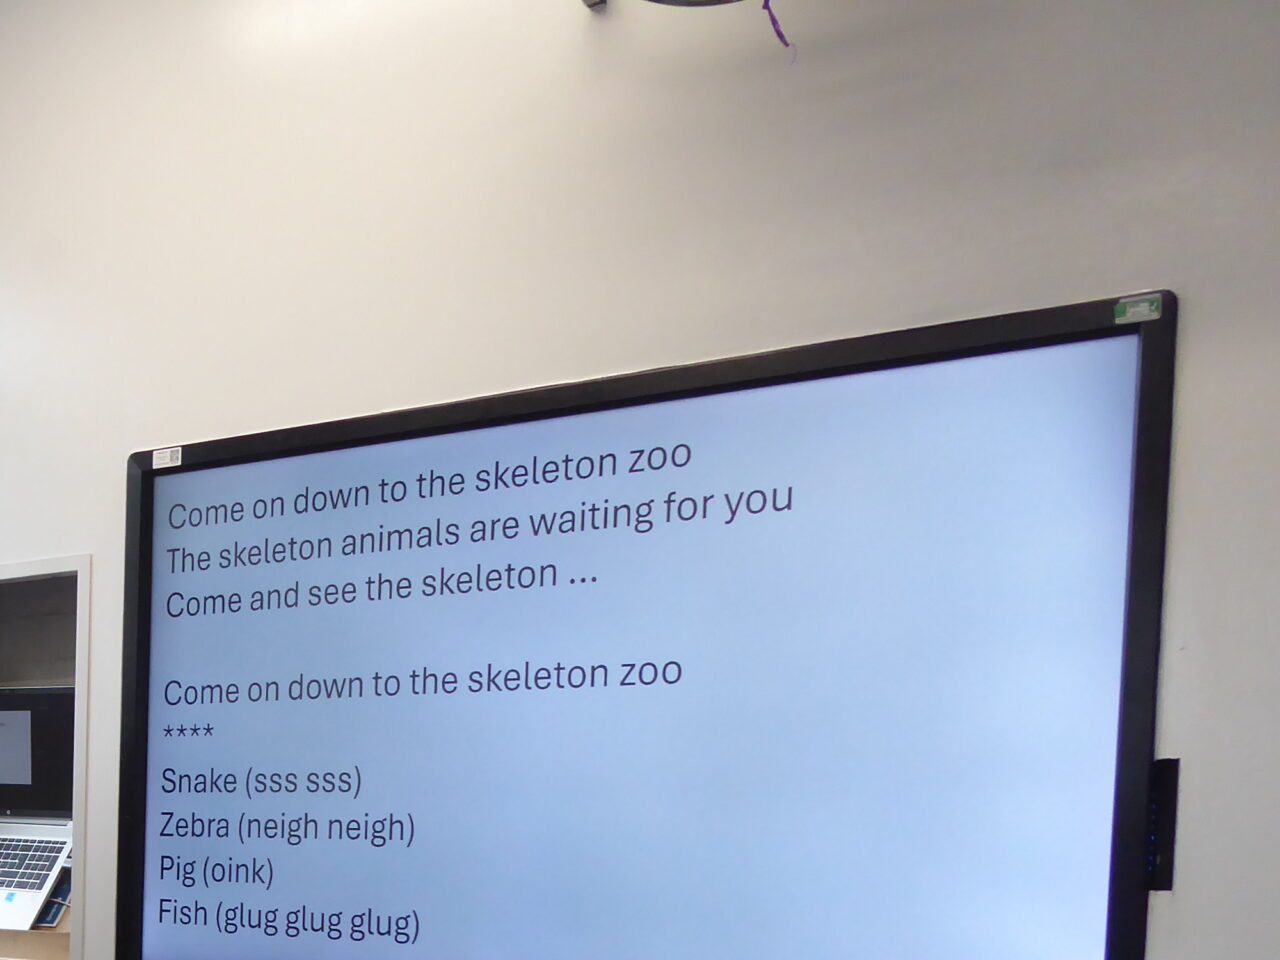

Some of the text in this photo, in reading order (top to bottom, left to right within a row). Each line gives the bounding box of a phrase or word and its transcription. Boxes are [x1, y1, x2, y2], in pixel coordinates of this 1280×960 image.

[168, 443, 692, 530] Come on down to the skeleton zoo
[166, 486, 793, 574] The skeleton animals are waiting for you
[166, 591, 242, 618] Come
[249, 580, 299, 612] and
[308, 582, 357, 607] see
[364, 572, 412, 602] the
[421, 563, 557, 597] skeleton
[164, 660, 683, 706] Come on down to the skeleton zoo
[161, 765, 362, 800] Snake (sss sss)
[159, 811, 415, 848] Zebra (neigh neigh)
[160, 855, 274, 891] Pig (oink)
[158, 898, 420, 945] Fish (glug glug glug)
